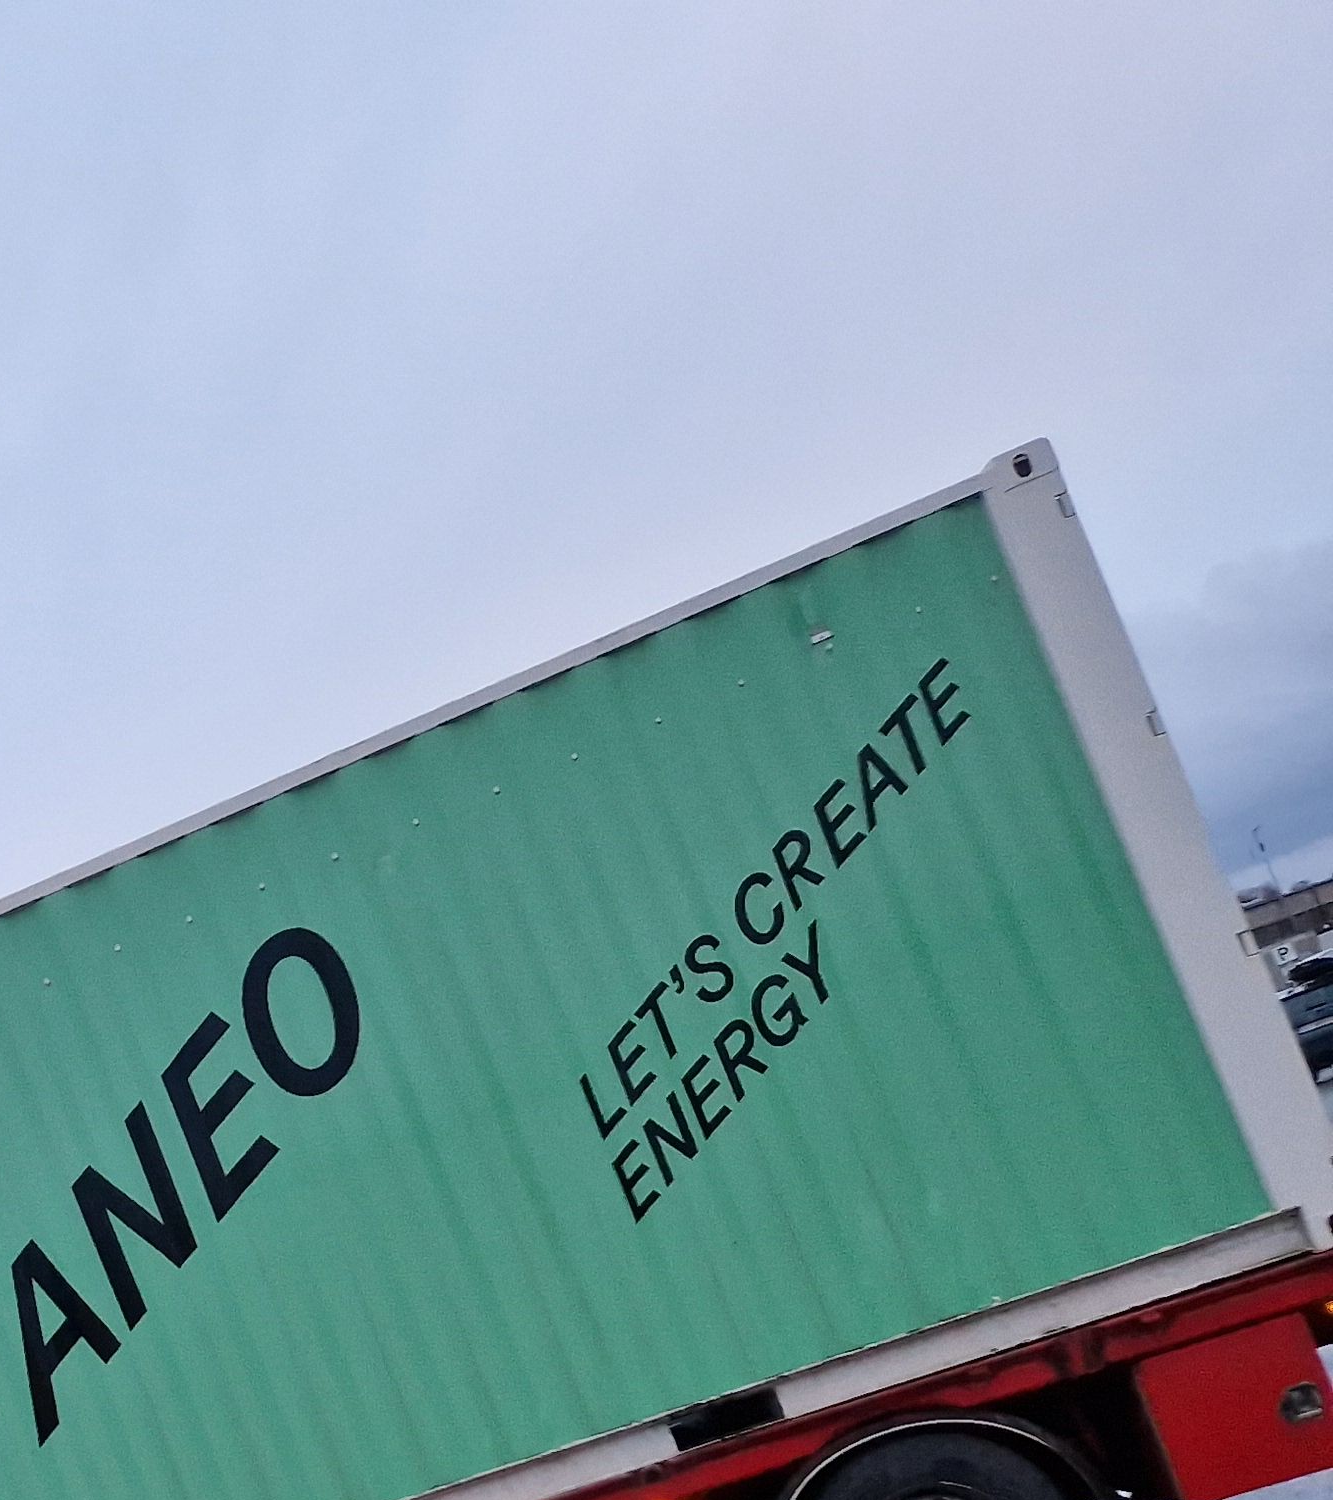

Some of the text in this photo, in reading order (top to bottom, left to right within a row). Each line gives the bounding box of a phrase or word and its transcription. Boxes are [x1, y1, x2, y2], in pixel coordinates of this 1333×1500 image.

[580, 658, 971, 1140] LET'S CREATE
[612, 920, 829, 1224] ENERGY
[1277, 947, 1288, 960] P
[11, 927, 360, 1447] ANEO
